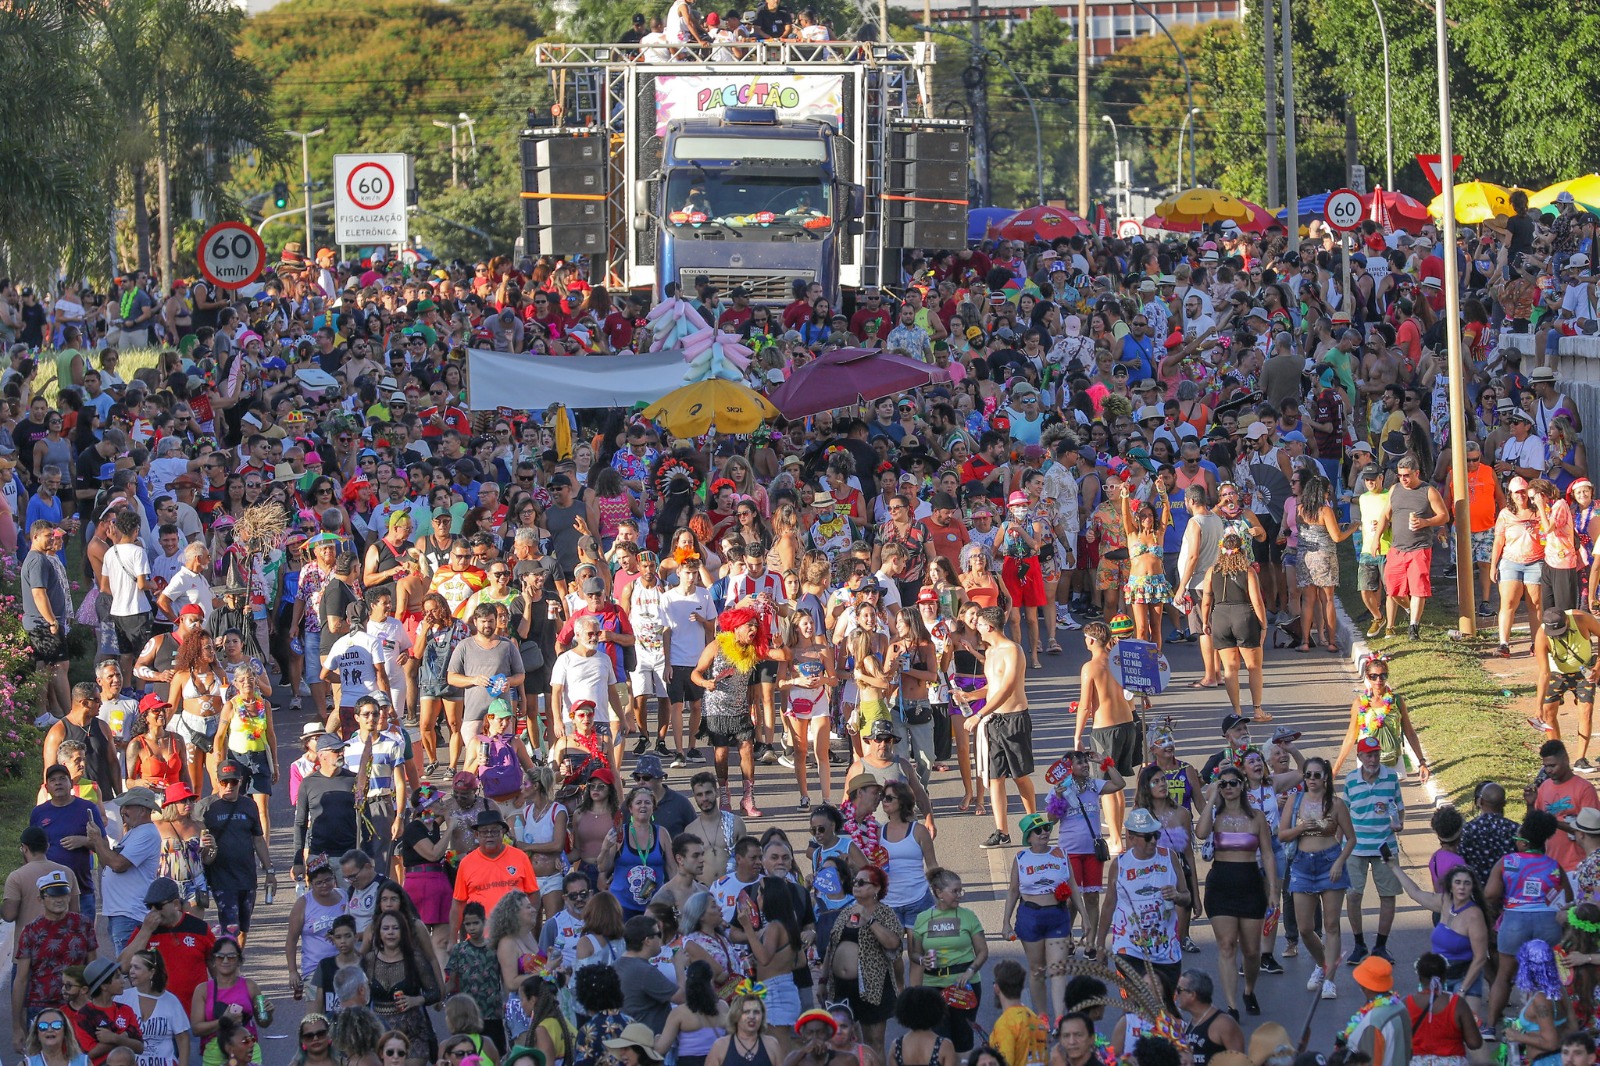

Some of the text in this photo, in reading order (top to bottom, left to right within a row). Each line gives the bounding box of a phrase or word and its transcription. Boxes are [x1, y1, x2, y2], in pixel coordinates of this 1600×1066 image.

[359, 178, 383, 193] 60
[1334, 202, 1356, 216] 60
[340, 212, 402, 223] FISCALIZAÇÃO
[346, 226, 397, 237] ELETRÔNICA
[1124, 227, 1136, 236] 60
[212, 234, 251, 259] 60
[216, 265, 248, 276] km/h
[1170, 501, 1185, 509] TREK
[340, 652, 360, 660] JUDO
[1122, 651, 1140, 660] DEPOIS
[1123, 667, 1138, 675] TUDO
[933, 922, 955, 931] DUNGA
